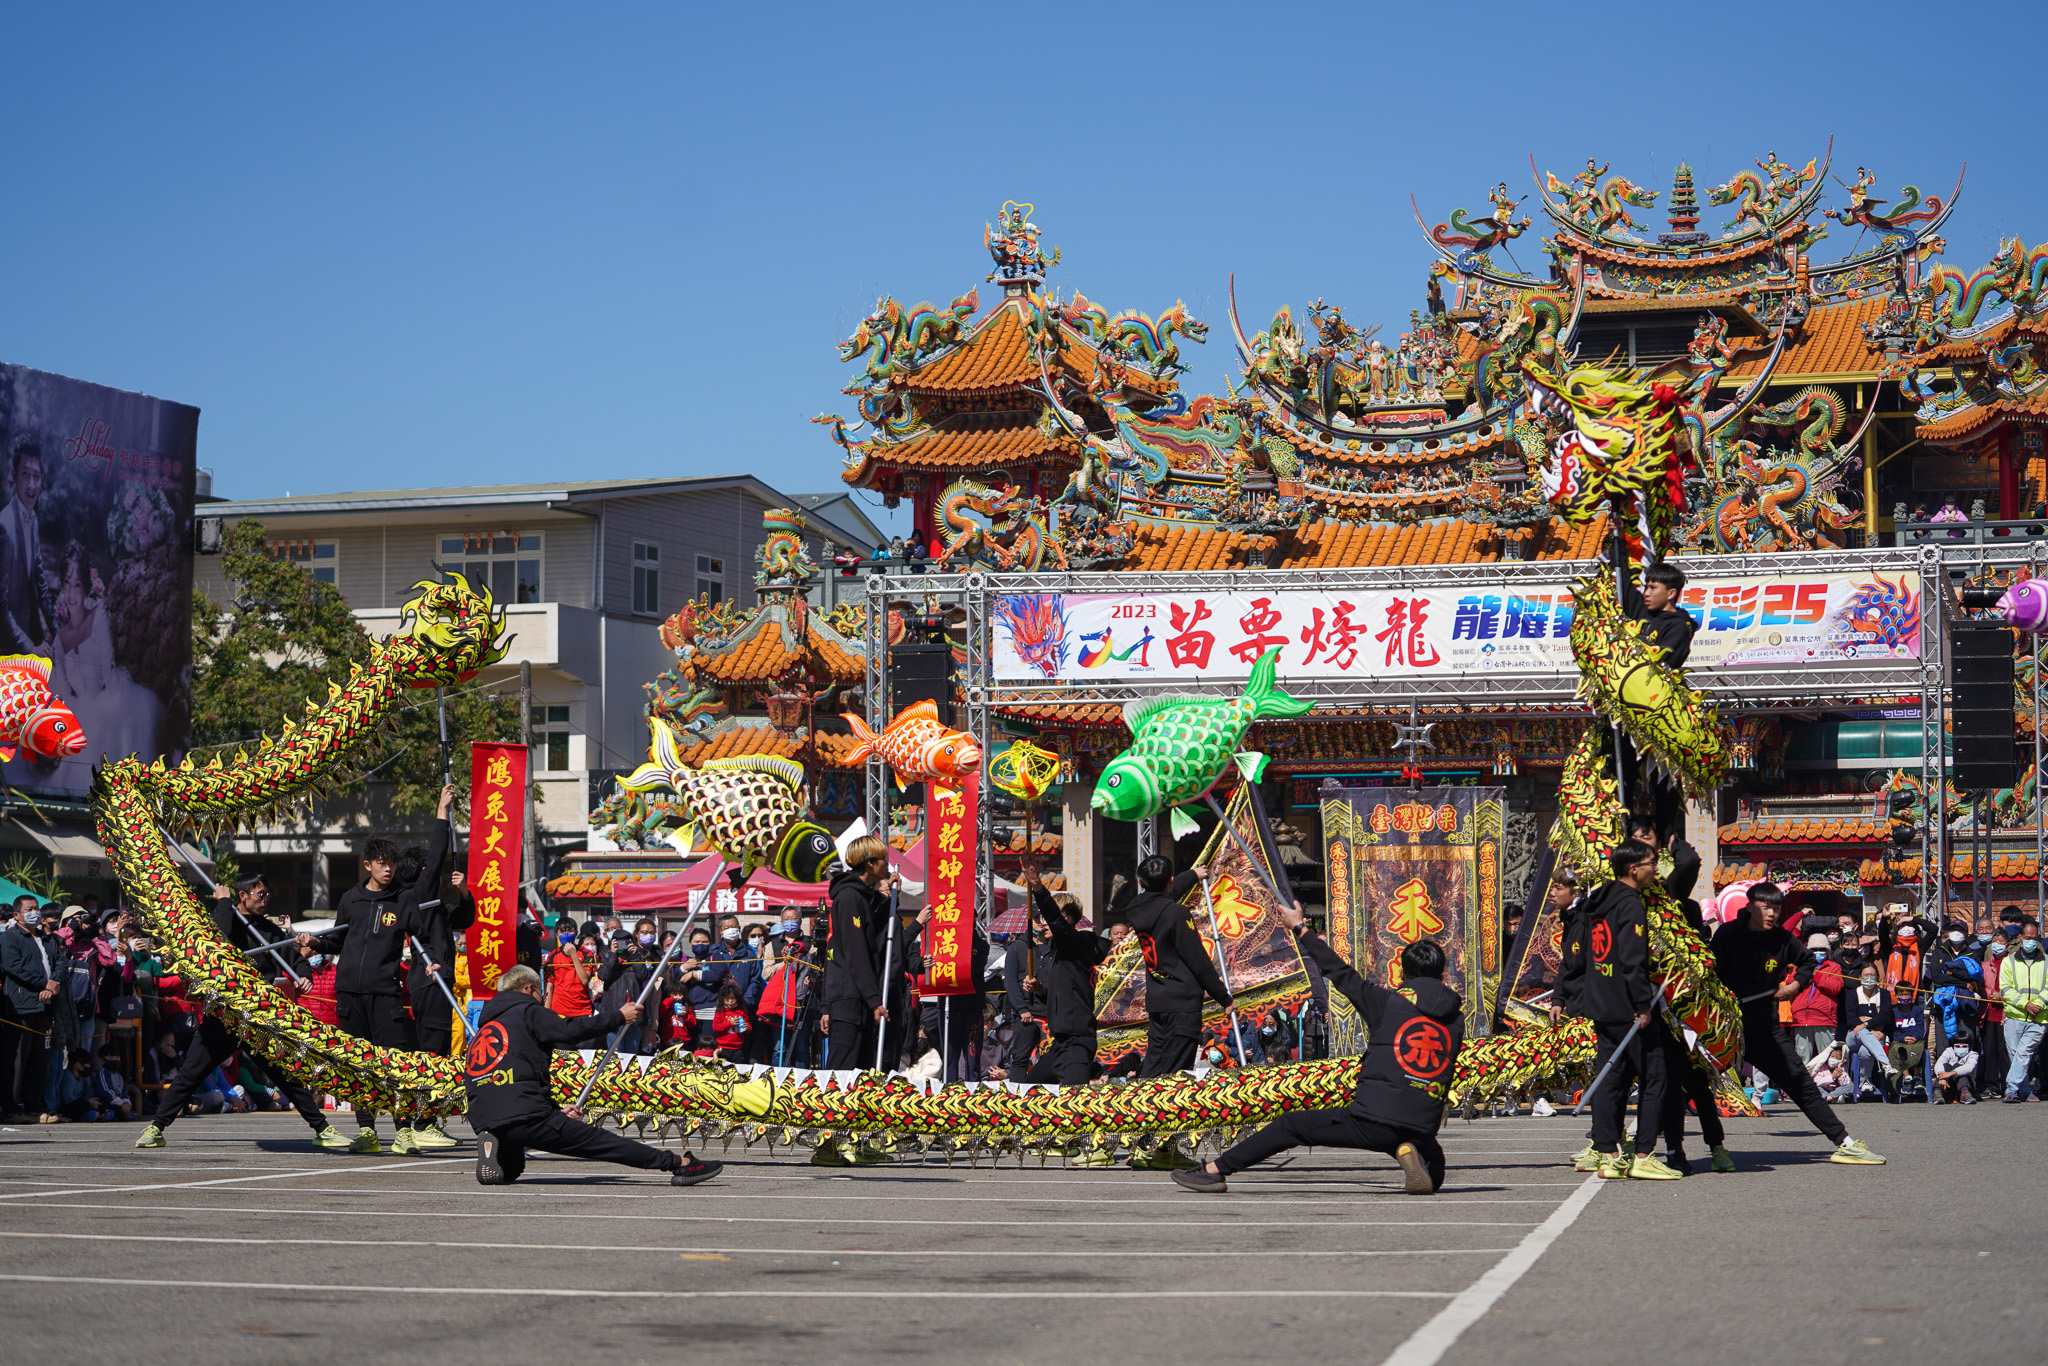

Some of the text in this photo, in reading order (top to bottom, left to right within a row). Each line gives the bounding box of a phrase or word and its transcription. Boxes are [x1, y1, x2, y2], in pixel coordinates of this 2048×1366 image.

[1111, 604, 1157, 619] 2023
[1370, 804, 1457, 833] 臺灣苗栗
[931, 776, 967, 987] 滿乾坤福滿門
[1896, 1017, 1916, 1028] FILA
